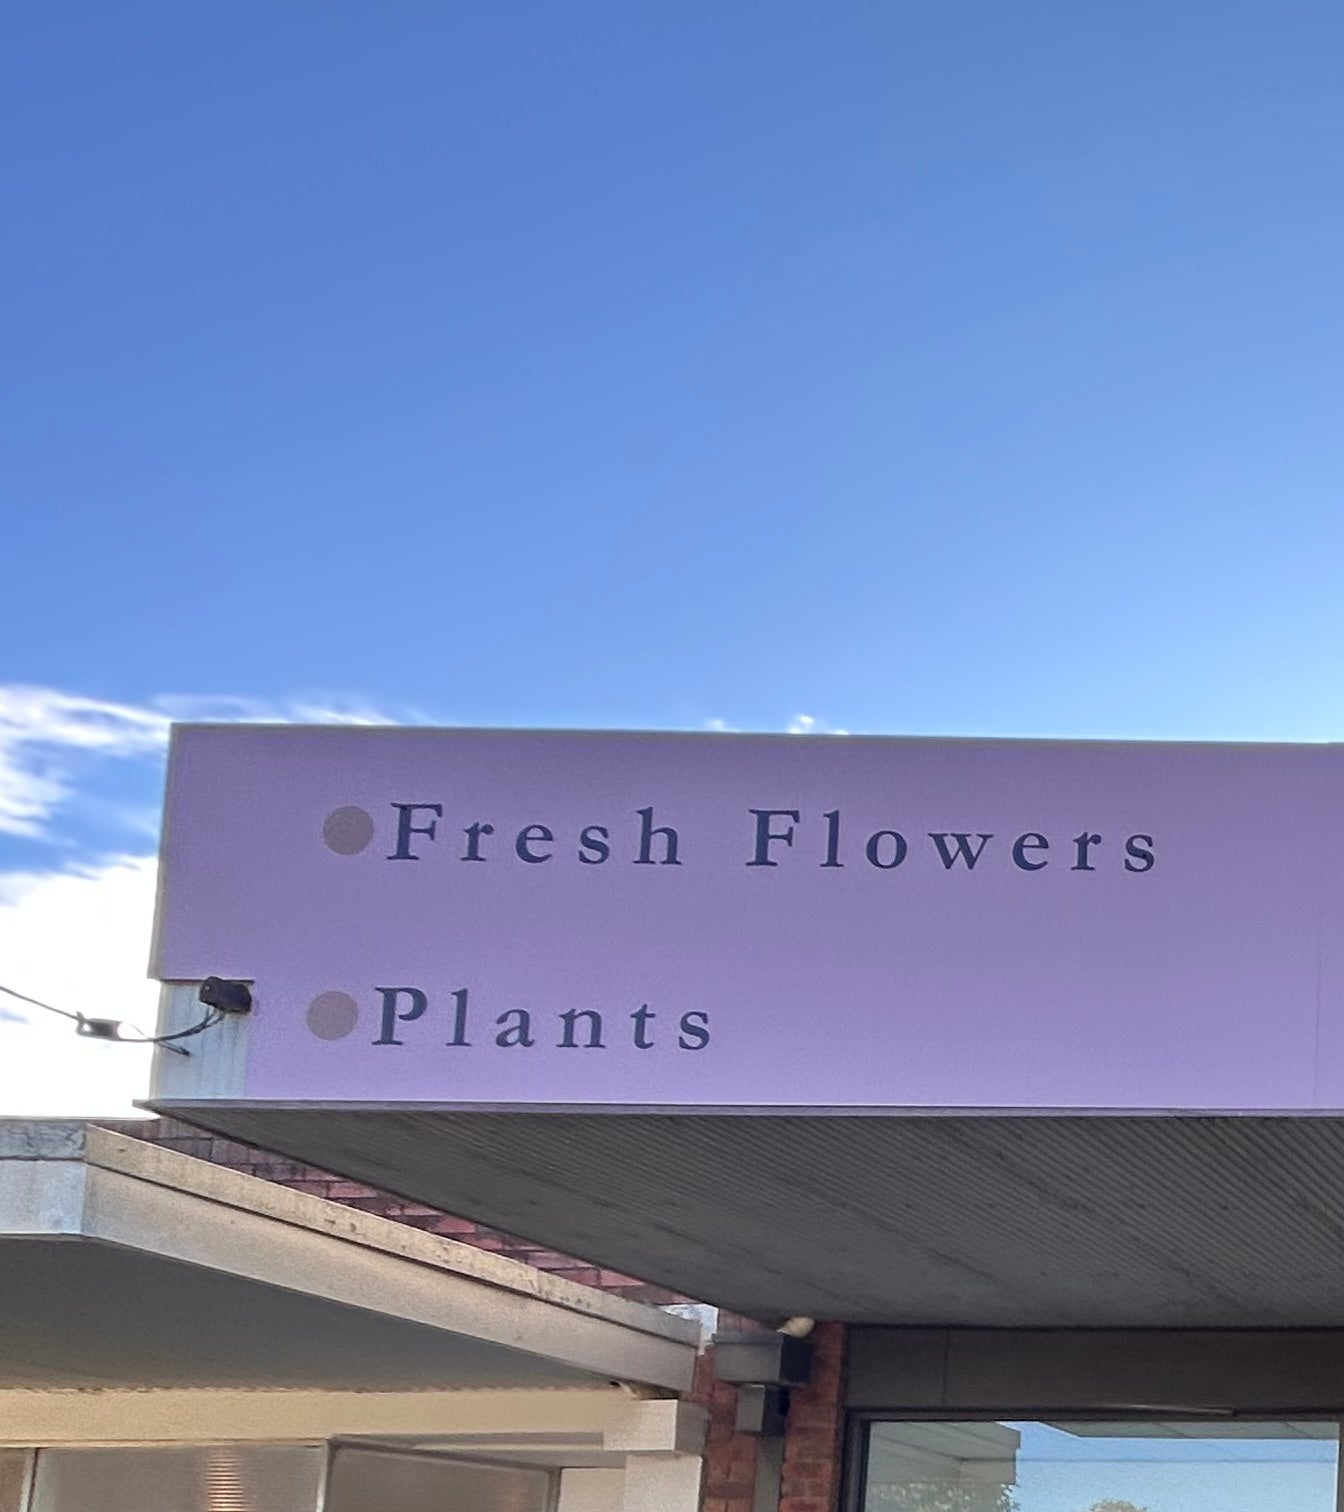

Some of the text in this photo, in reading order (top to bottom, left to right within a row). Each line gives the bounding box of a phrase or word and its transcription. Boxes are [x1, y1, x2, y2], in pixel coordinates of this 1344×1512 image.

[385, 801, 1156, 874] Fresh Flowers
[370, 985, 711, 1052] Plants
